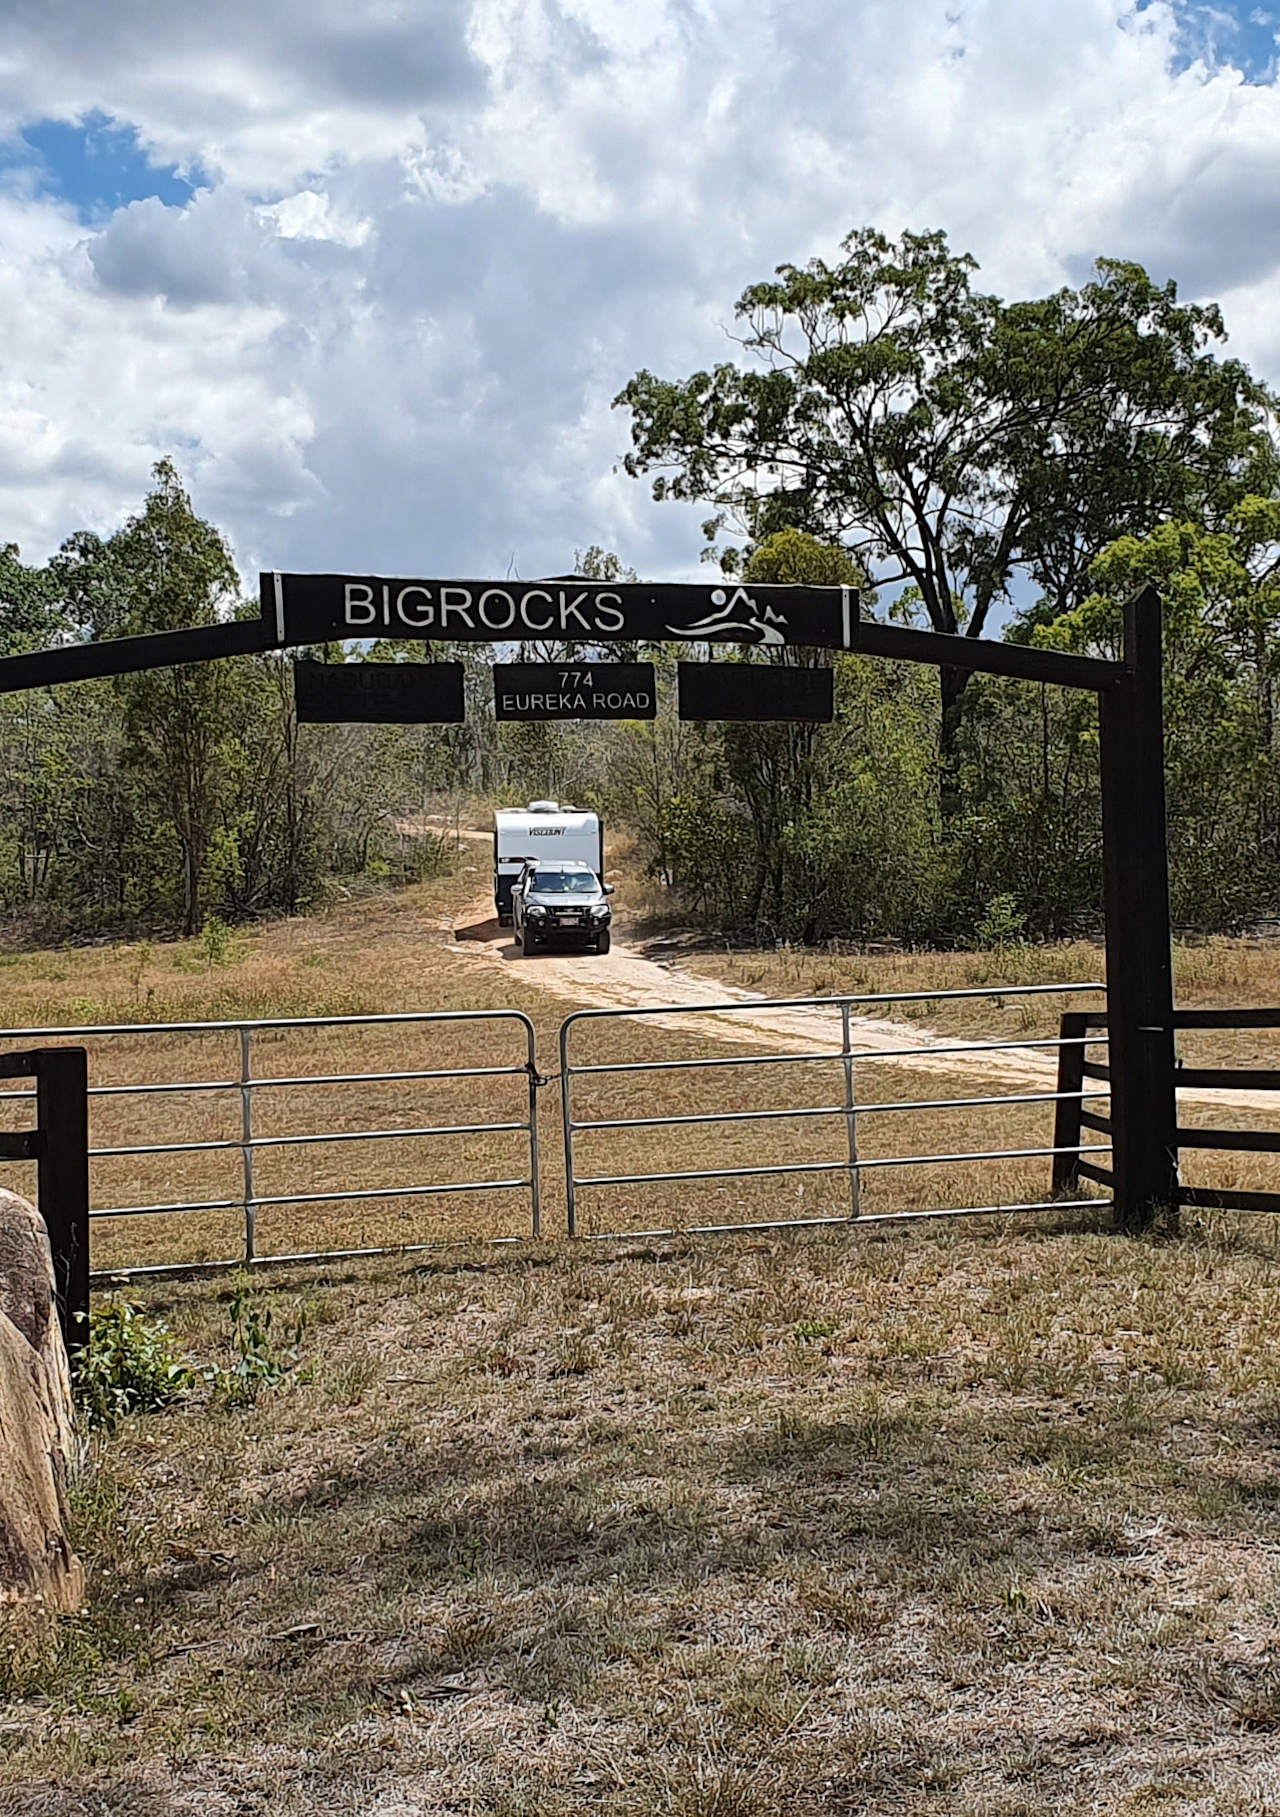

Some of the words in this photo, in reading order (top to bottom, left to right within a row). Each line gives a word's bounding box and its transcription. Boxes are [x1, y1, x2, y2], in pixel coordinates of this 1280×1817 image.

[344, 583, 625, 632] BIGROCKS
[558, 671, 594, 689] 774
[502, 693, 587, 711] EUREKA
[592, 692, 650, 710] ROAD
[528, 826, 567, 837] VISCOUNT
